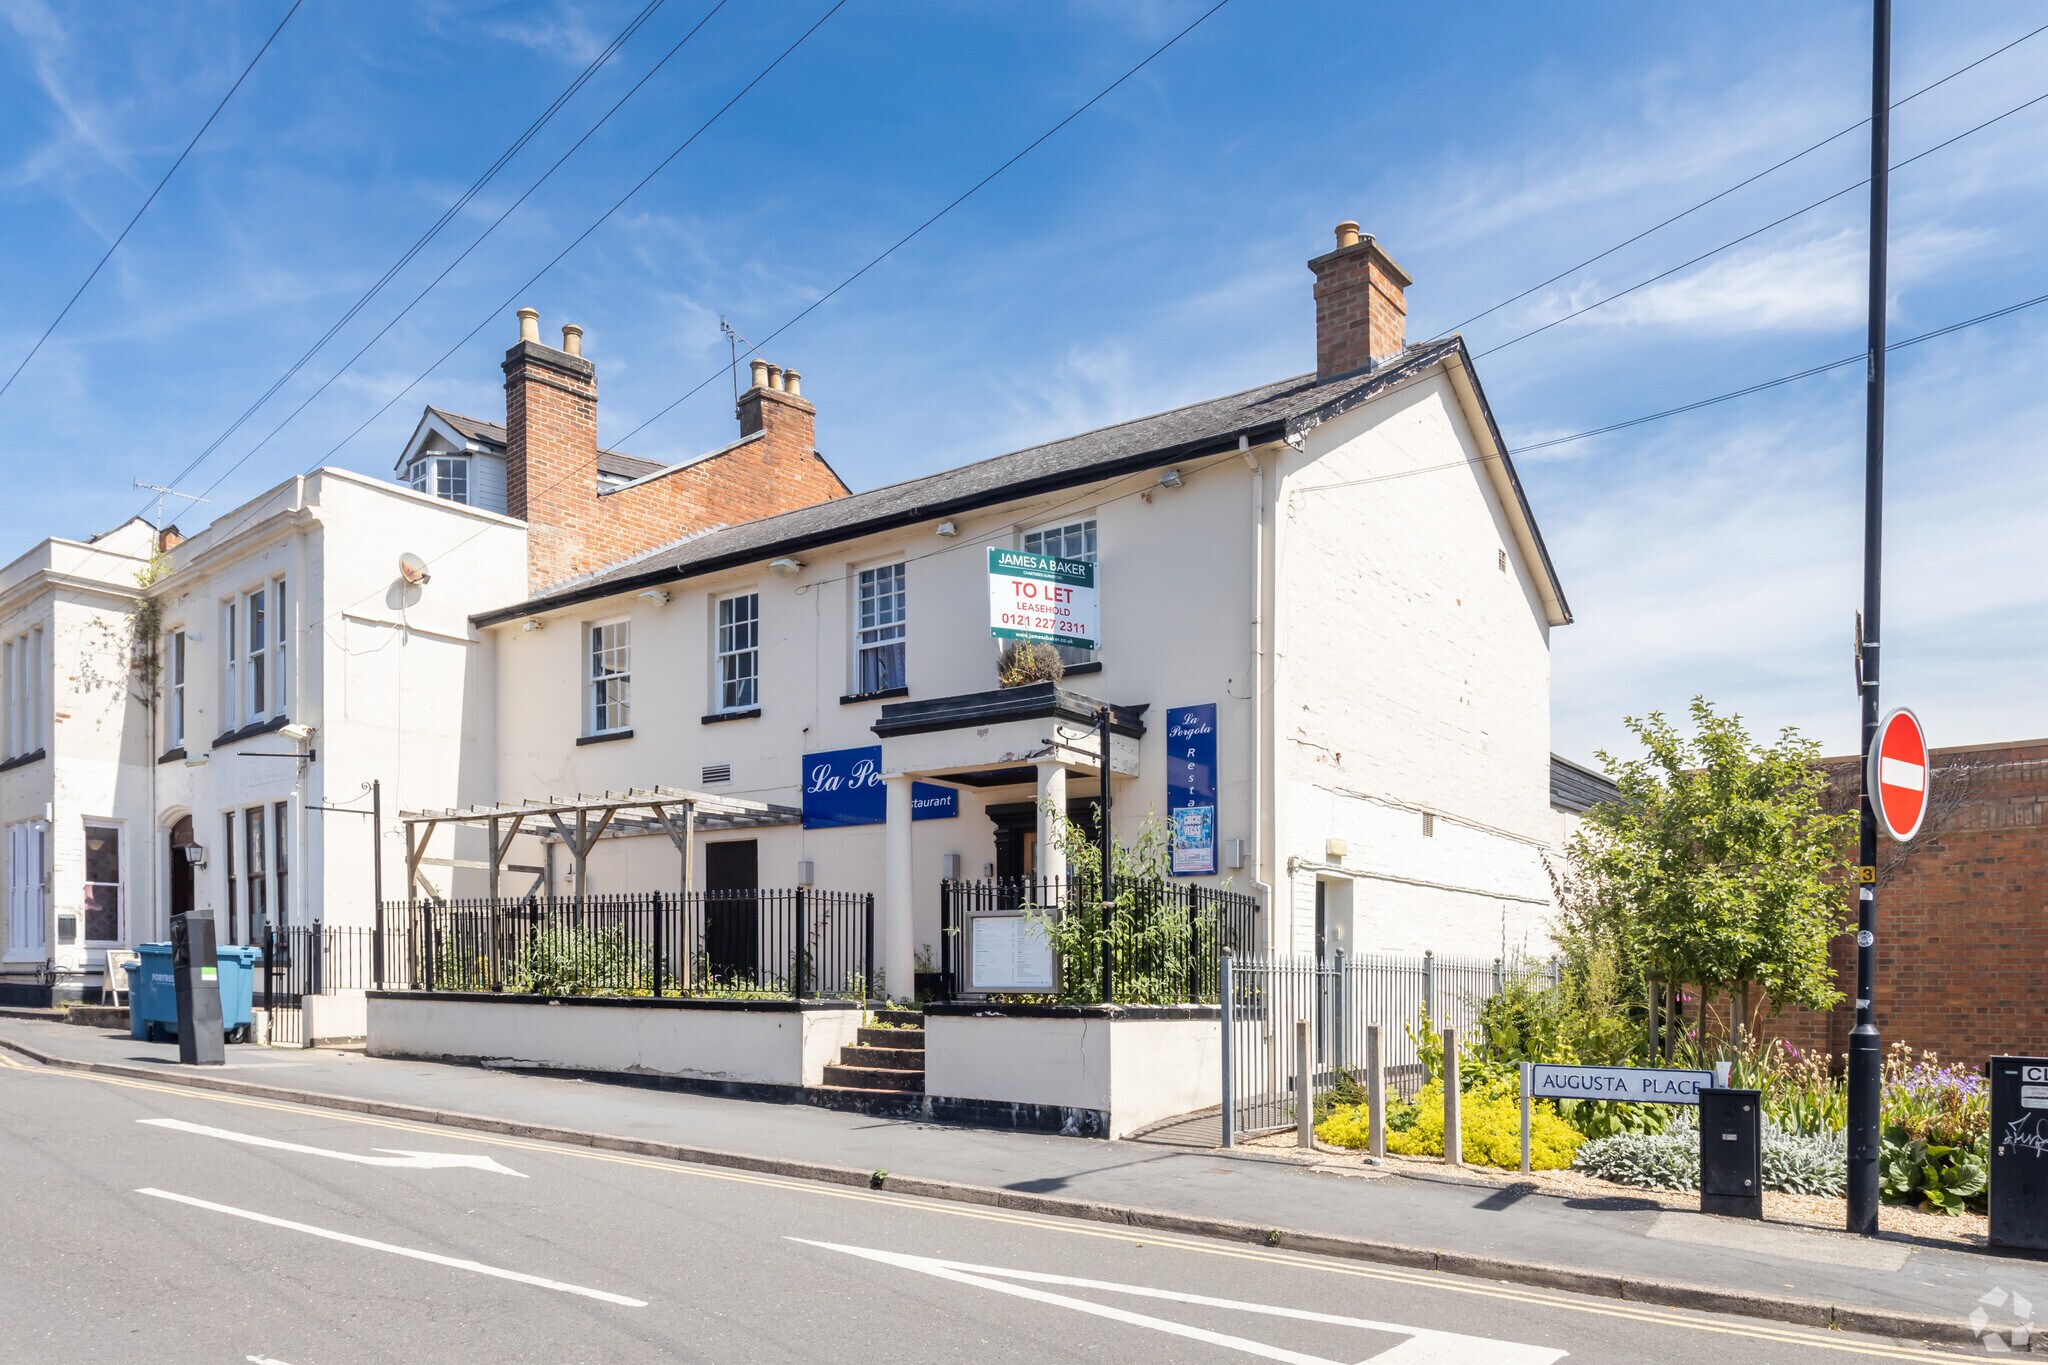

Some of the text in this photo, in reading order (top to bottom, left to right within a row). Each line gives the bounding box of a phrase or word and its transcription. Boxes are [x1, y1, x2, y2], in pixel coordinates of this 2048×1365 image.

[999, 553, 1086, 576] JAMES A BAKER
[1011, 581, 1073, 603] TO LET
[1017, 602, 1071, 616] LEASEHOLD
[1001, 613, 1085, 634] 0121 227 2311
[1182, 713, 1199, 725] La
[1169, 723, 1213, 740] Pergola
[808, 763, 844, 793] La
[1862, 868, 1872, 881] 3
[1542, 1074, 1700, 1095] AUGUSTA PLACE
